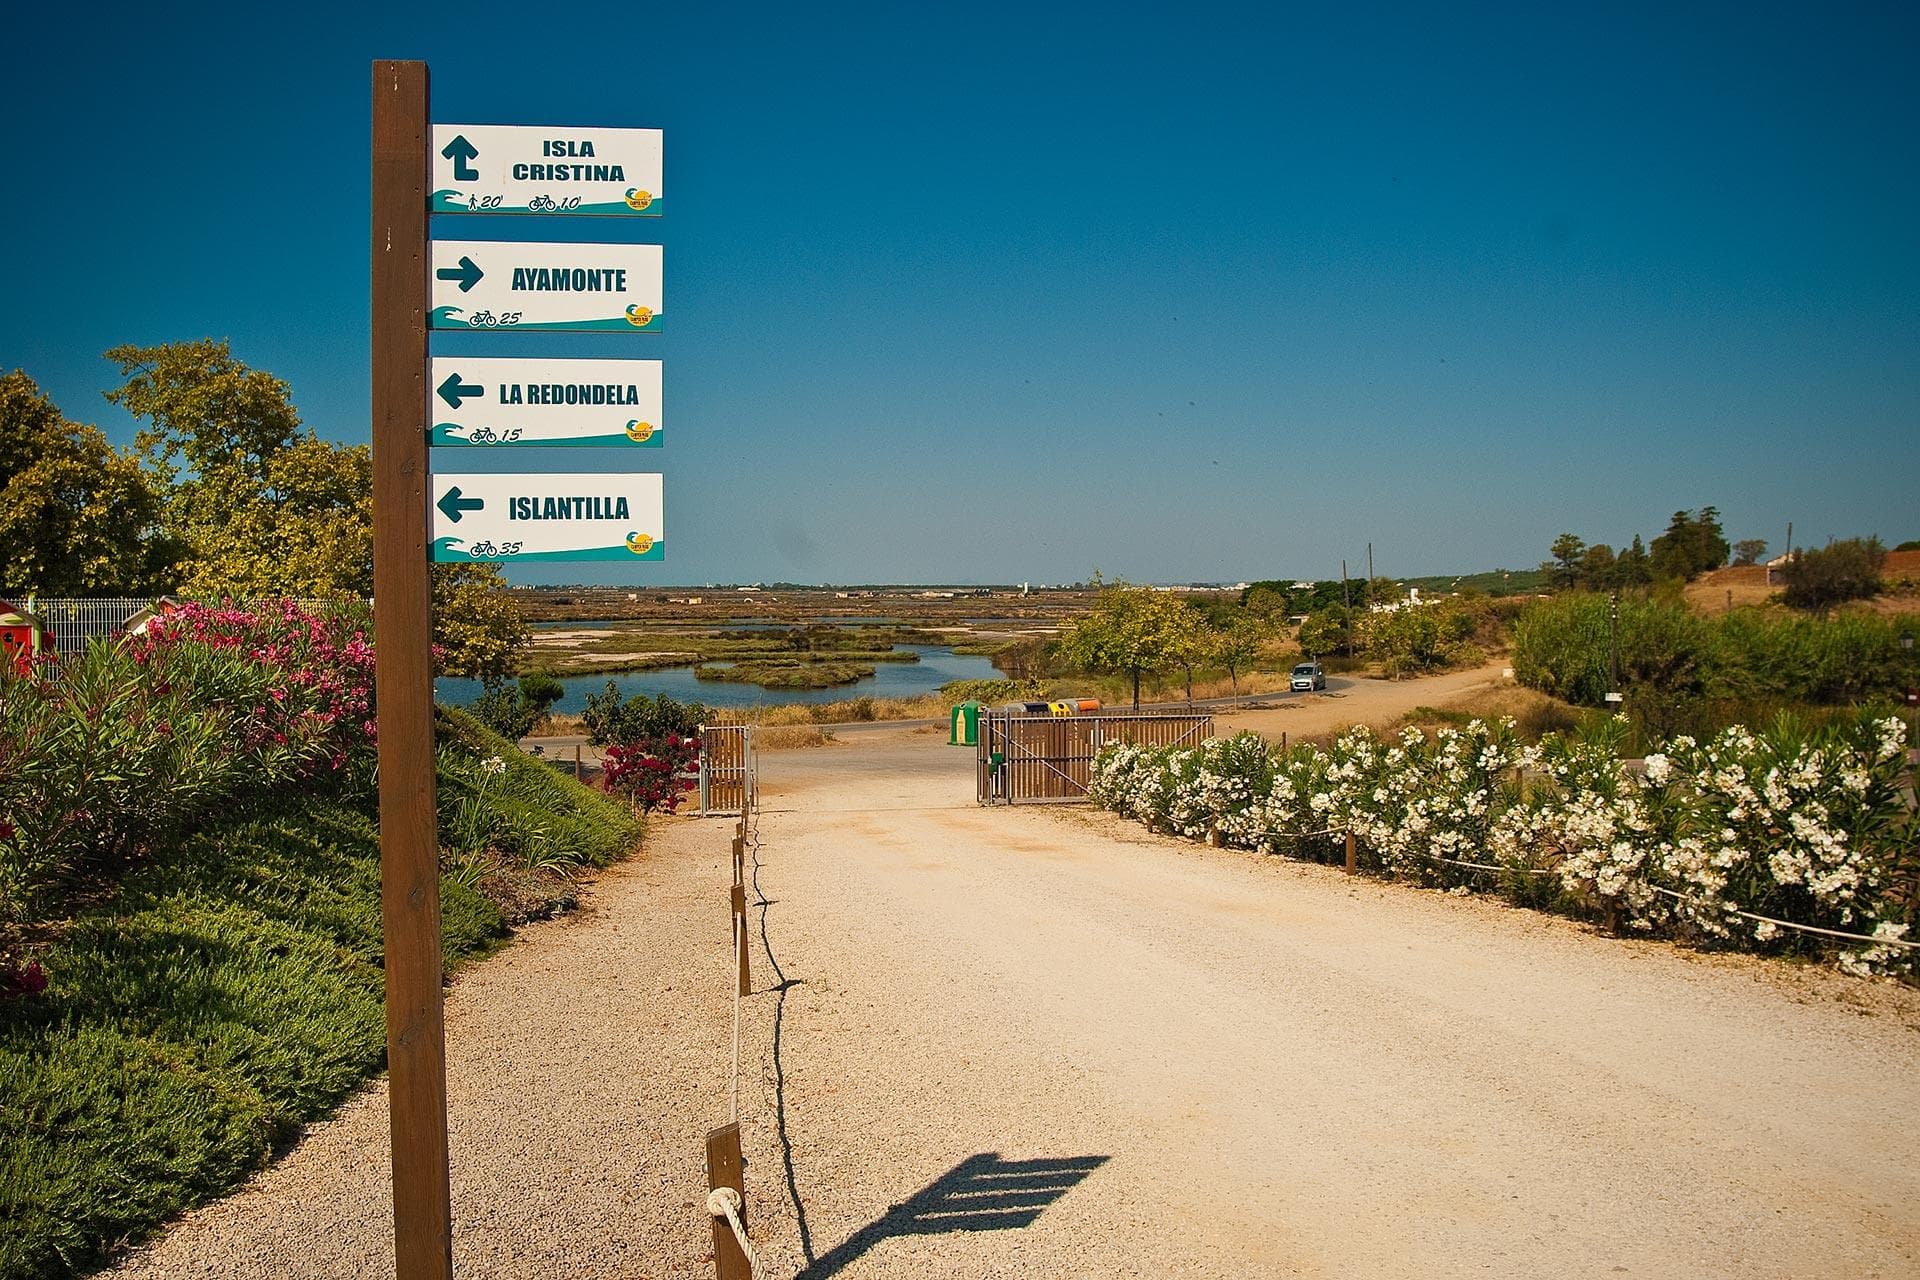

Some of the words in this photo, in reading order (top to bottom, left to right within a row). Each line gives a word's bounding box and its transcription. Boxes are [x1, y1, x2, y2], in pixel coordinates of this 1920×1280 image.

[543, 140, 595, 157] ISLA
[513, 163, 625, 181] CRISTINA
[512, 268, 627, 291] AYAMONTE
[500, 384, 522, 405] LA
[527, 384, 639, 405] REDONDELA
[509, 497, 630, 520] ISLANTILLA
